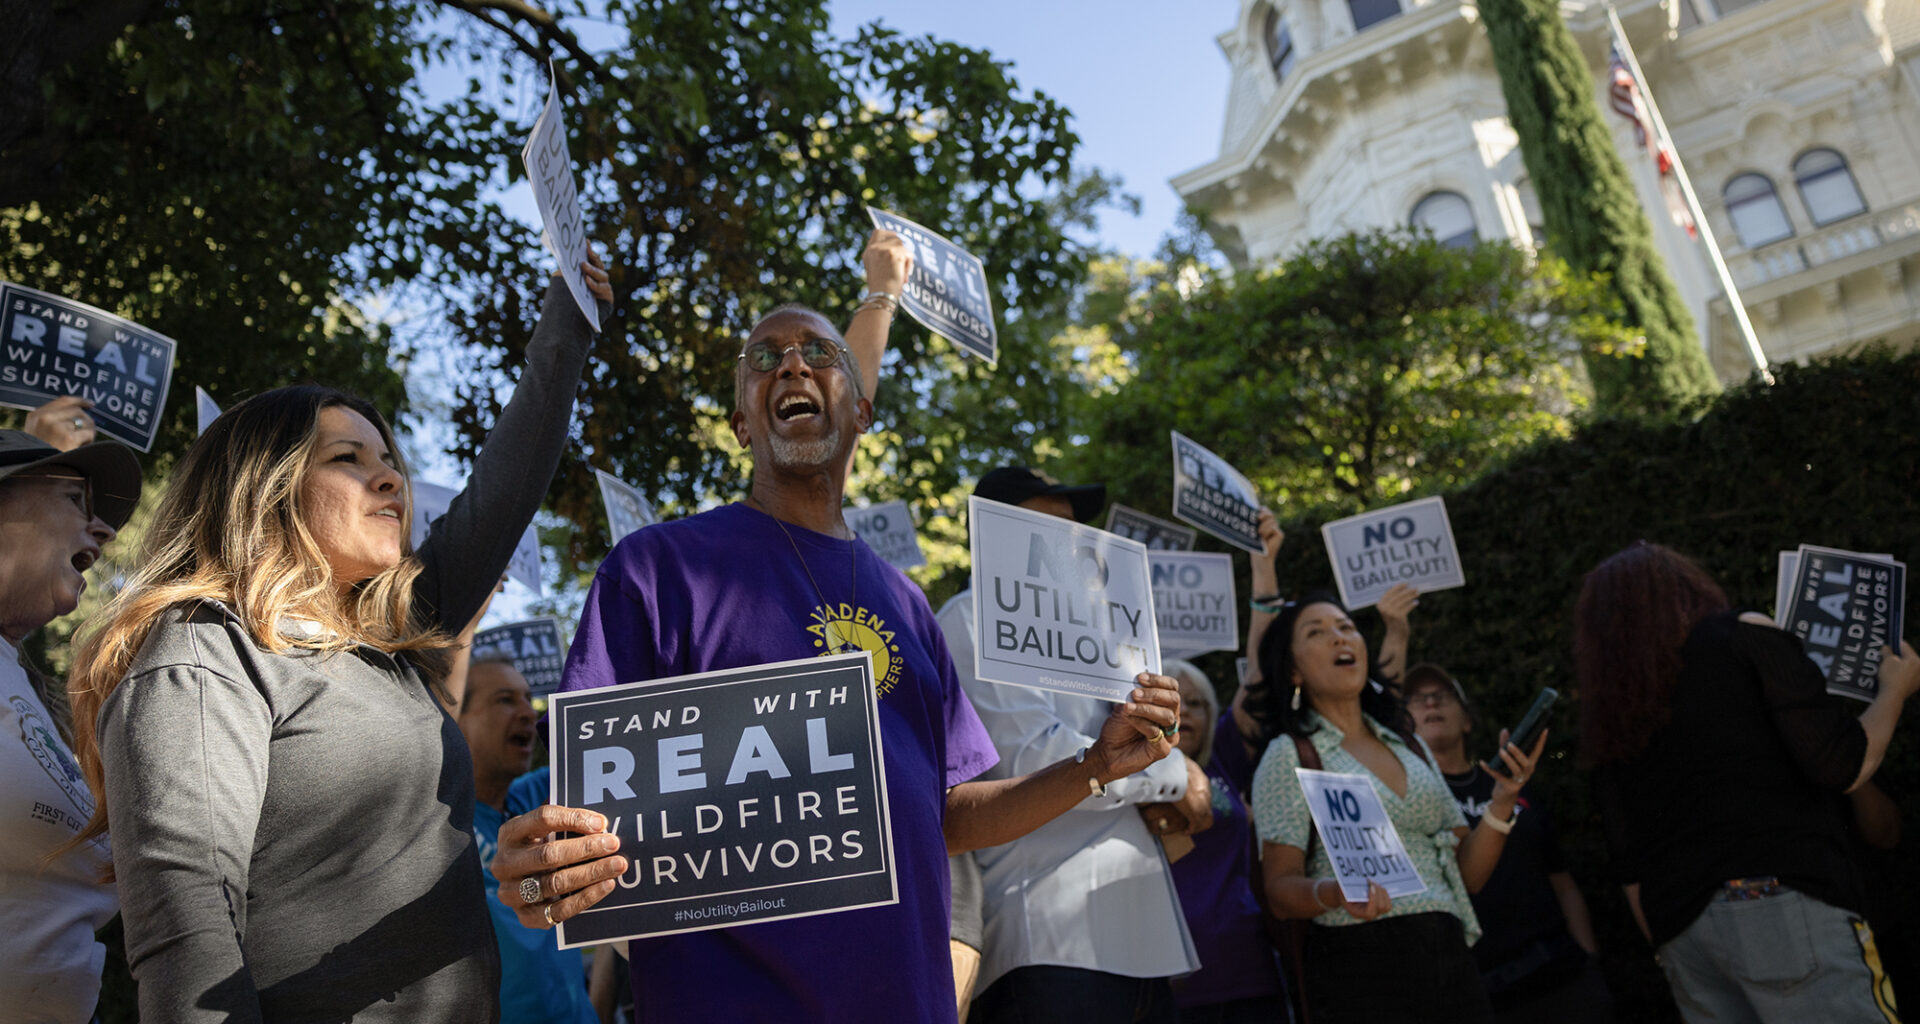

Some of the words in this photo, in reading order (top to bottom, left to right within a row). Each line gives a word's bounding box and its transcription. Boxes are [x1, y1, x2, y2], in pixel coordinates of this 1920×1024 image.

[908, 263, 986, 316] ILDFIRE
[11, 313, 157, 386] REAL
[13, 300, 89, 329] STAND
[114, 330, 163, 358] WITH
[2, 366, 149, 426] SURVIVORS
[7, 345, 154, 406] WILDFIRE
[1346, 536, 1442, 572] UTILITY
[1363, 516, 1416, 548] NO
[1026, 532, 1109, 591] NO
[1152, 563, 1203, 589] NO
[1352, 557, 1449, 592] BAILOUT!
[1805, 558, 1824, 602] WITH
[994, 576, 1141, 638] UTILITY
[1152, 590, 1226, 612] TILITY
[1156, 612, 1227, 633] ILOUT!
[995, 619, 1149, 673] BAILOUT!
[1836, 566, 1872, 682] WILDFIRE
[1858, 570, 1889, 690] SURVIVORS
[875, 656, 904, 700] PHERS
[1040, 676, 1121, 697] #StandWithSurvivors
[578, 706, 701, 740] STAND
[753, 686, 848, 715] WITH
[582, 717, 855, 806] REAL
[33, 802, 66, 821] FIRST
[66, 815, 84, 831] CIT
[1324, 788, 1361, 823] NO
[617, 830, 864, 889] URVIVORS
[1324, 825, 1390, 851] UTILITY
[1336, 853, 1407, 878] BAILOUT!
[674, 897, 787, 922] #NoUtilityBailout
